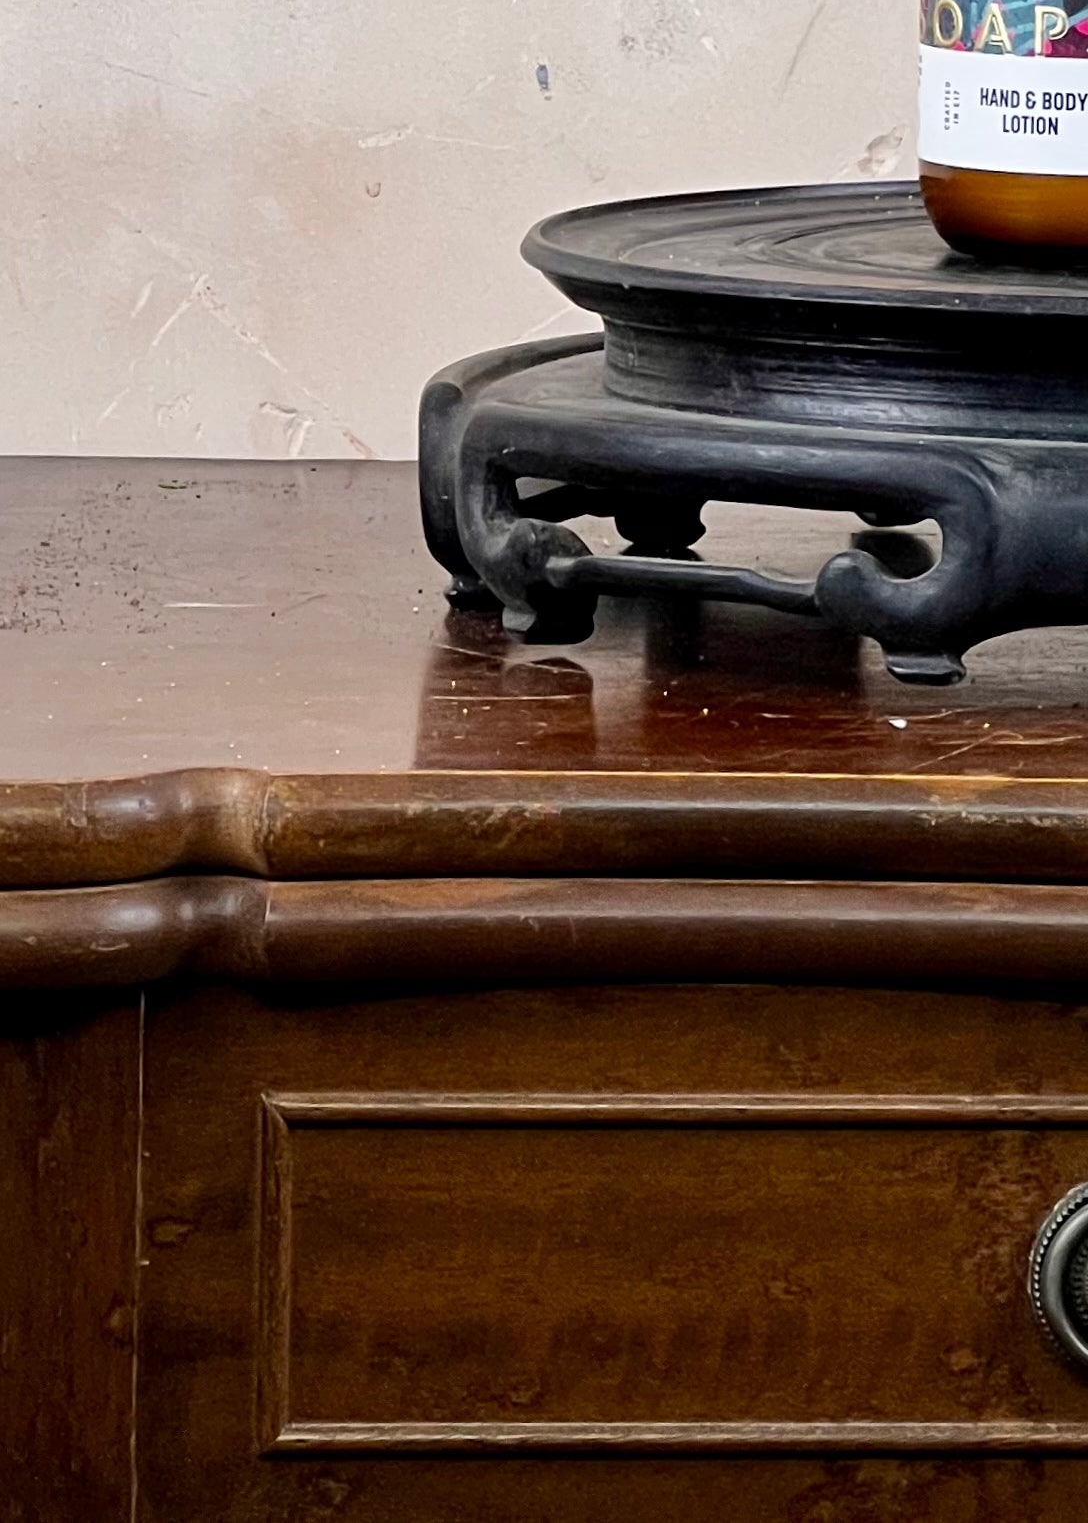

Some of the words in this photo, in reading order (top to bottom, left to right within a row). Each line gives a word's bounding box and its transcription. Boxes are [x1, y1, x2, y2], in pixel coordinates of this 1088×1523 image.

[980, 87, 1021, 109] HAND
[1025, 90, 1037, 109] &
[1042, 92, 1088, 111] BODY
[1002, 114, 1059, 135] LOTION
